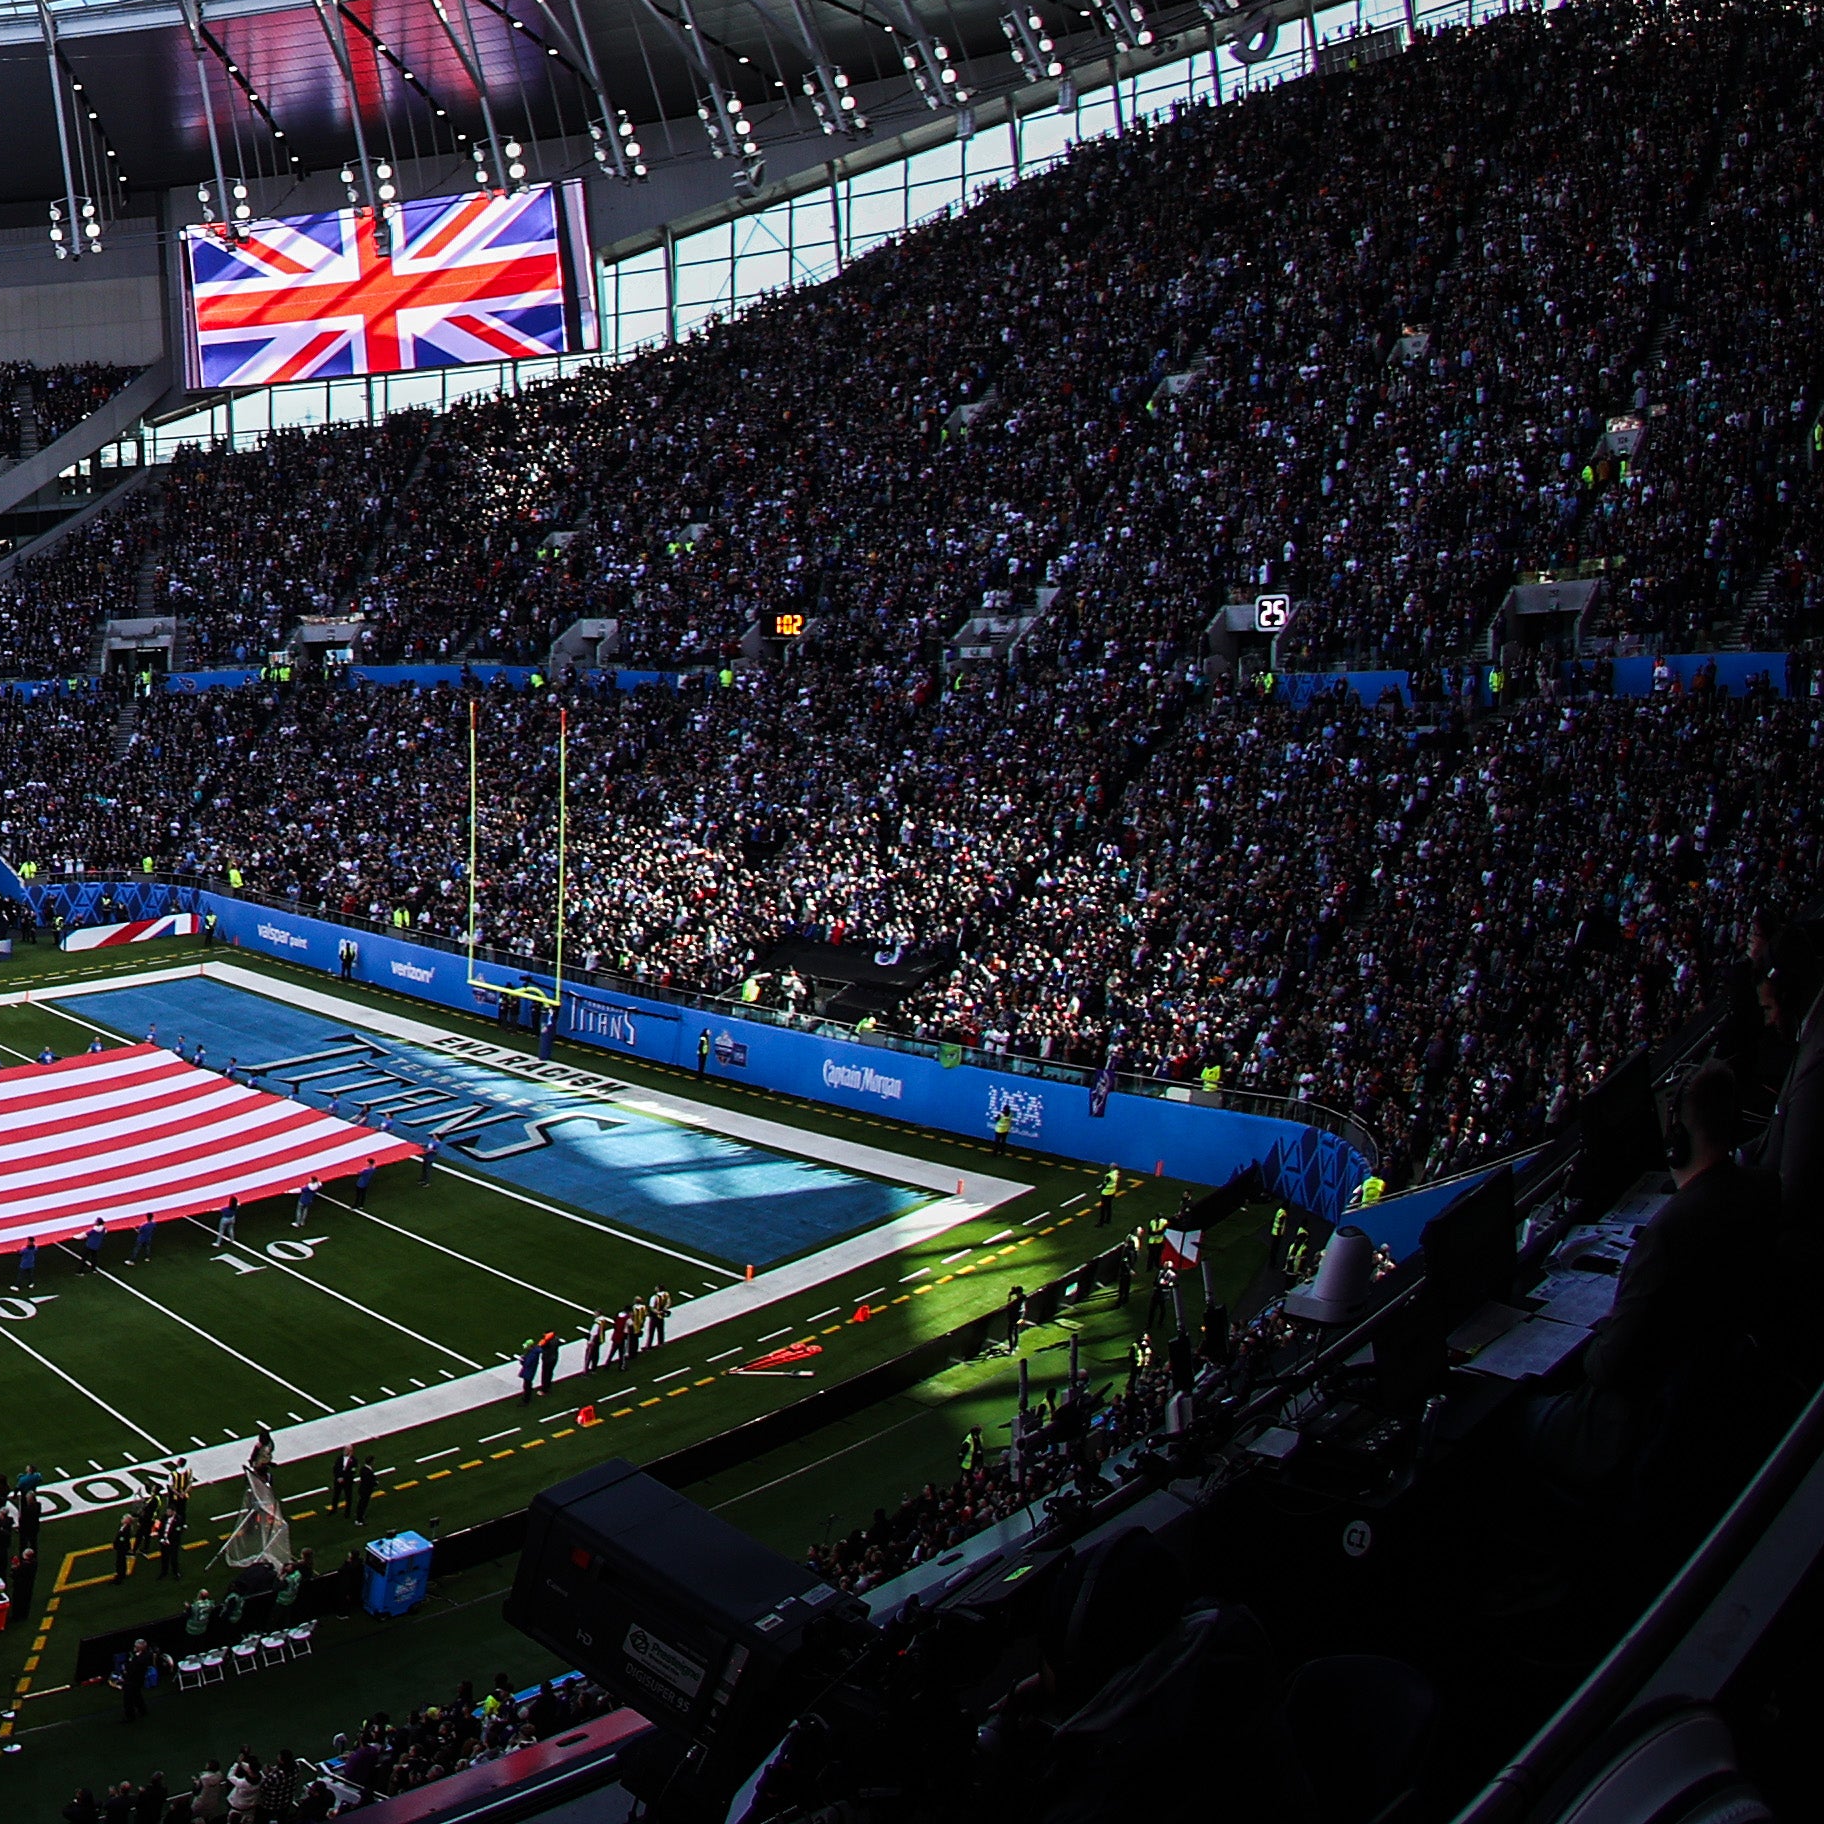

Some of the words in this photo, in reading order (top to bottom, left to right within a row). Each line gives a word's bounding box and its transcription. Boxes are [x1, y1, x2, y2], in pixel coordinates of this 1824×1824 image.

[1266, 606, 1283, 622] 25
[391, 960, 435, 983] verizon
[568, 991, 637, 1047] TITANS
[434, 1037, 498, 1059] END
[495, 1053, 631, 1096] RACISM
[822, 1059, 863, 1093] Captain
[862, 1065, 903, 1100] Morgan
[234, 1033, 631, 1163] TITANS
[209, 1237, 317, 1277] 10
[1347, 1529, 1365, 1549] C1
[625, 1662, 677, 1703] DIGISUPER
[676, 1696, 692, 1714] 95
